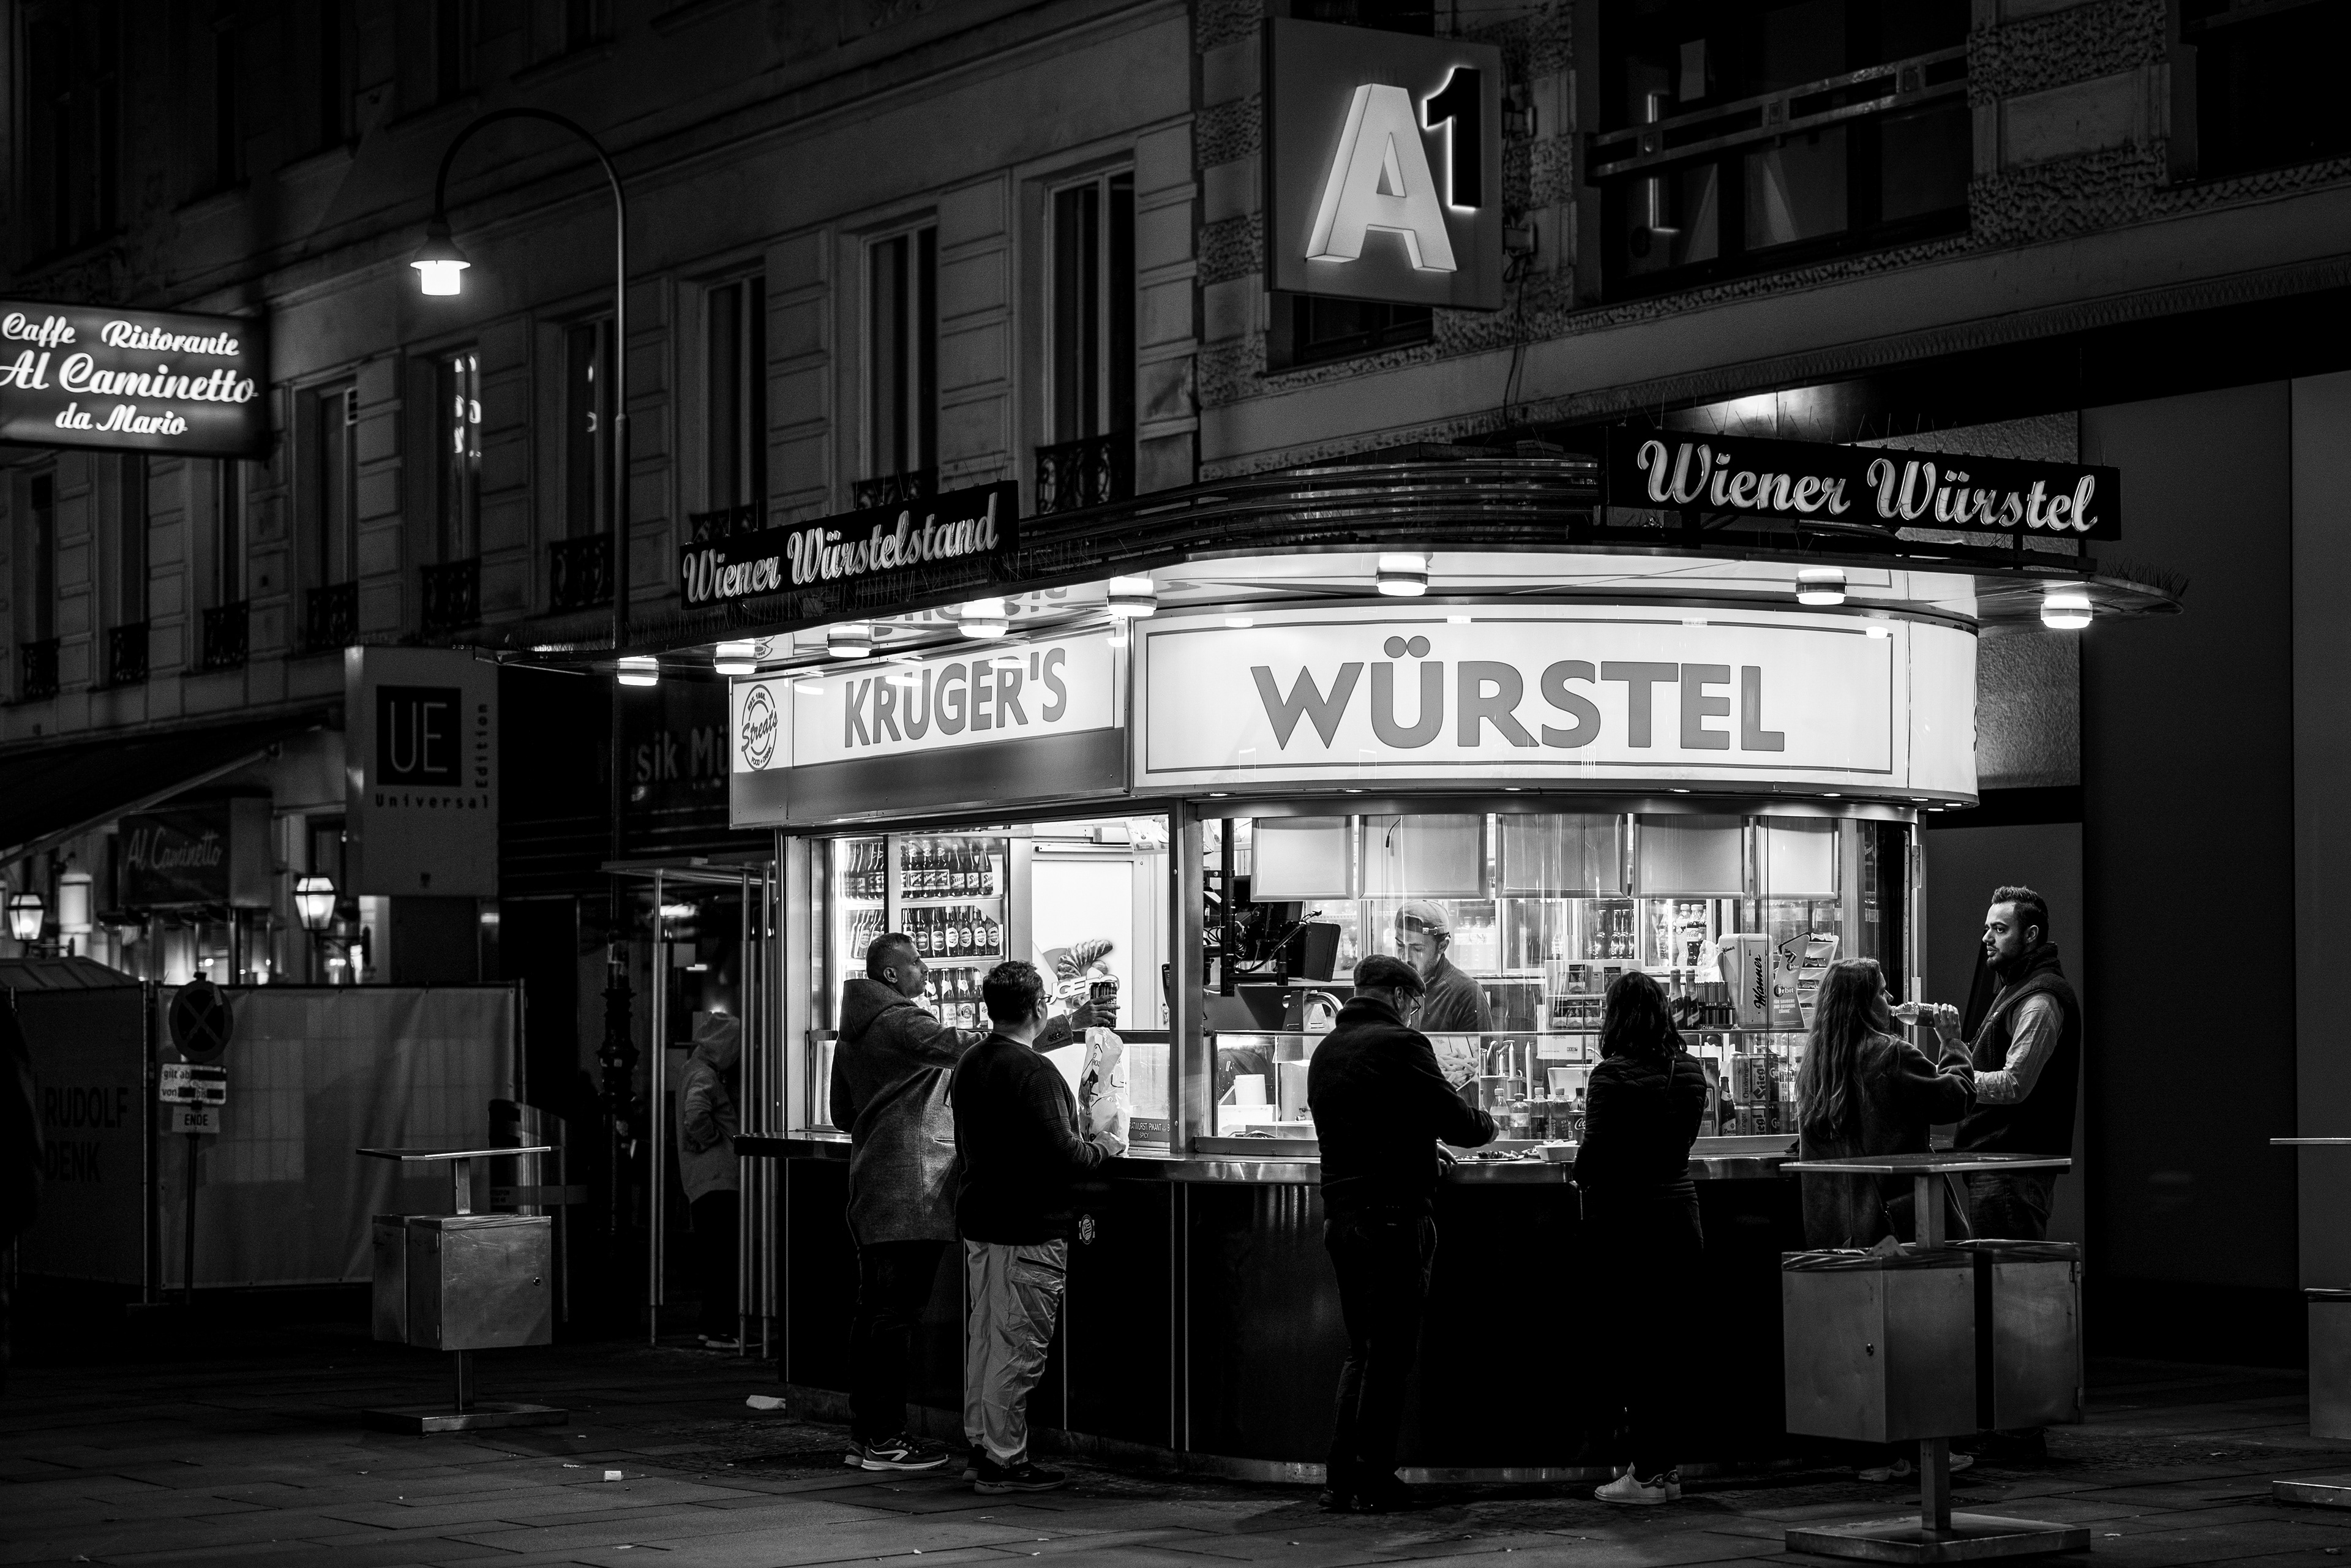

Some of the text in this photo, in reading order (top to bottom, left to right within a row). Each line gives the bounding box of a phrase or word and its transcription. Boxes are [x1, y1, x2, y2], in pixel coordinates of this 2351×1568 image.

[1305, 64, 1482, 272] A1
[2, 312, 239, 356] Caffe Ristorante
[0, 349, 259, 403] Al Caminetto
[55, 402, 188, 435] da Mario
[1637, 439, 2098, 533] Wiener Würstel
[683, 492, 1000, 602] Wiener Würstelstand
[1250, 635, 1785, 752] WÜRSTEL
[389, 700, 448, 773] UE
[475, 704, 487, 789] Edition
[741, 709, 778, 752] Streats
[375, 793, 489, 809] Universal
[126, 825, 223, 872] Al Caminetto
[1752, 954, 1766, 1009] Manner
[1774, 984, 1794, 997] Orbit
[1752, 1064, 1766, 1099] Stiegl
[45, 1087, 129, 1128] RUDOLF
[184, 1114, 209, 1126] ENDE
[45, 1140, 101, 1183] DENK
